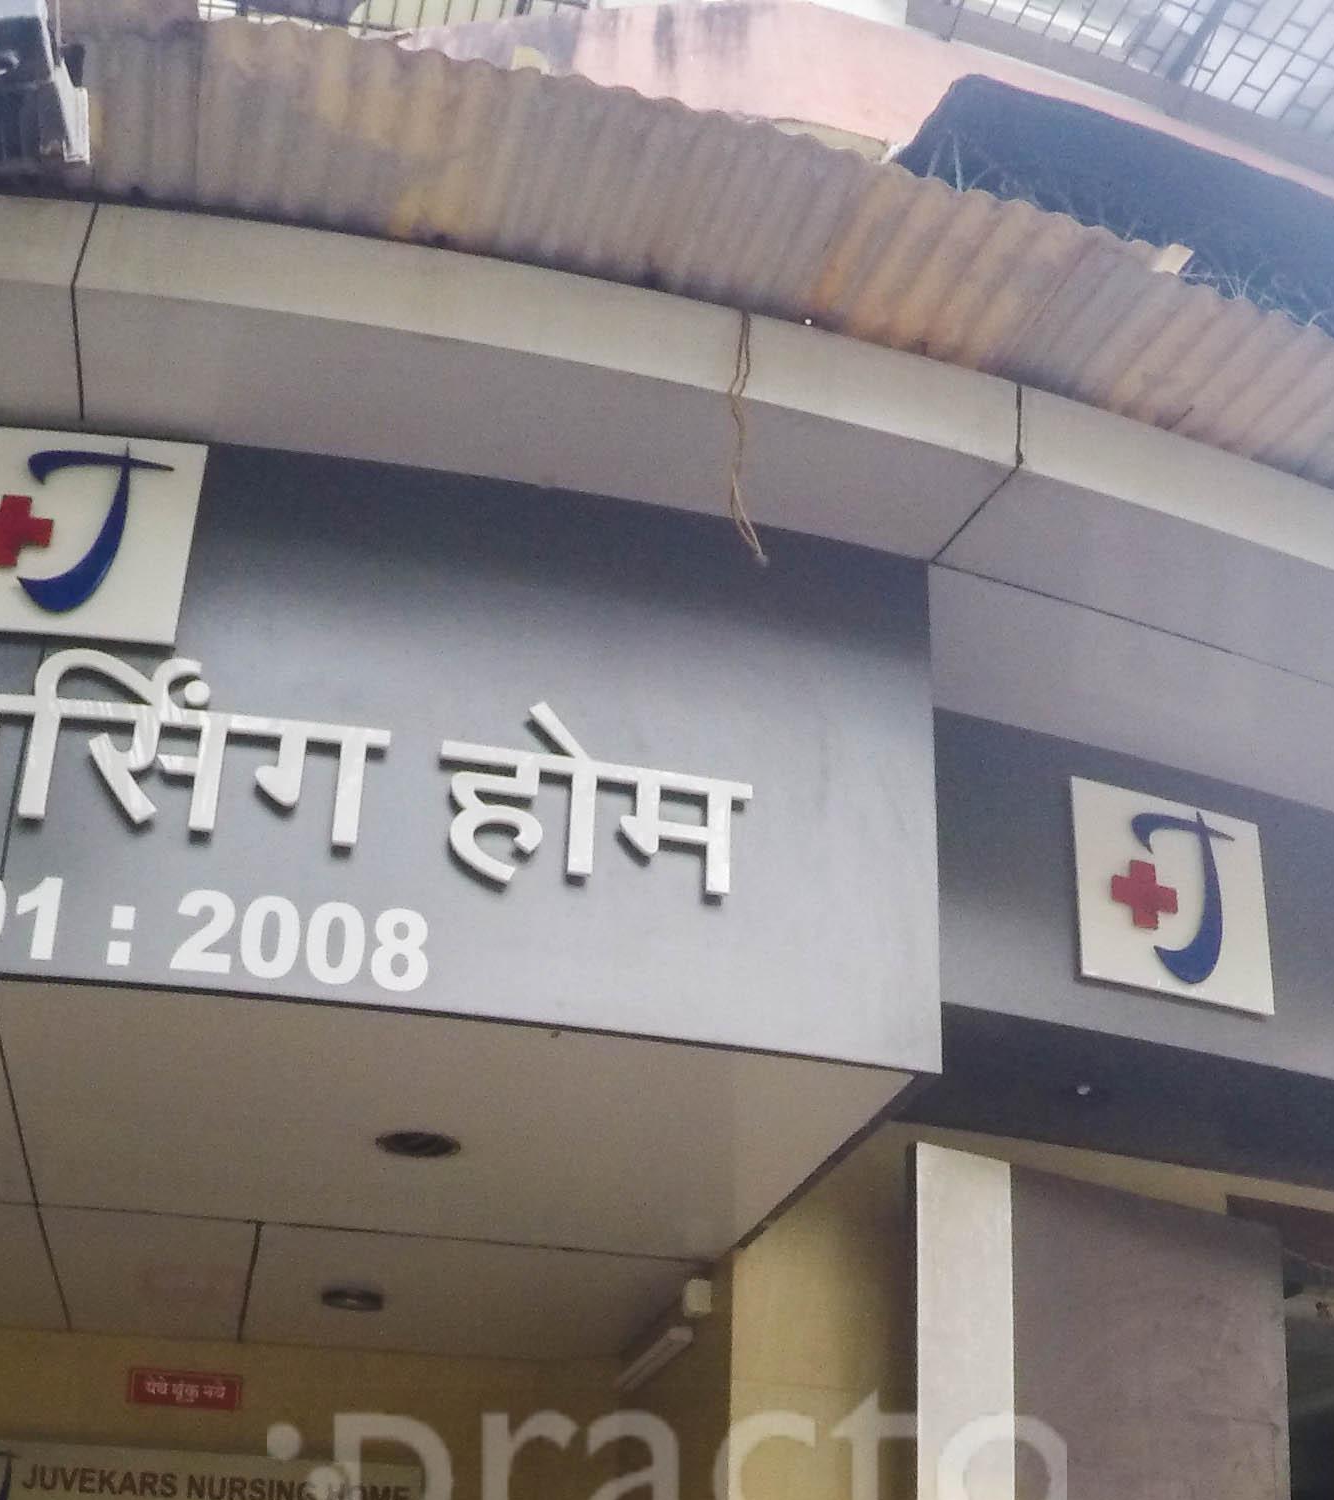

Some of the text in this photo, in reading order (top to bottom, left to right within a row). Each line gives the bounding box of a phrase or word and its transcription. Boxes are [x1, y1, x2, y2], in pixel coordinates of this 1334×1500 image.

[439, 701, 753, 896] होम
[107, 904, 136, 966] :
[169, 889, 430, 992] 2008
[22, 1463, 177, 1499] JUVEKARS
